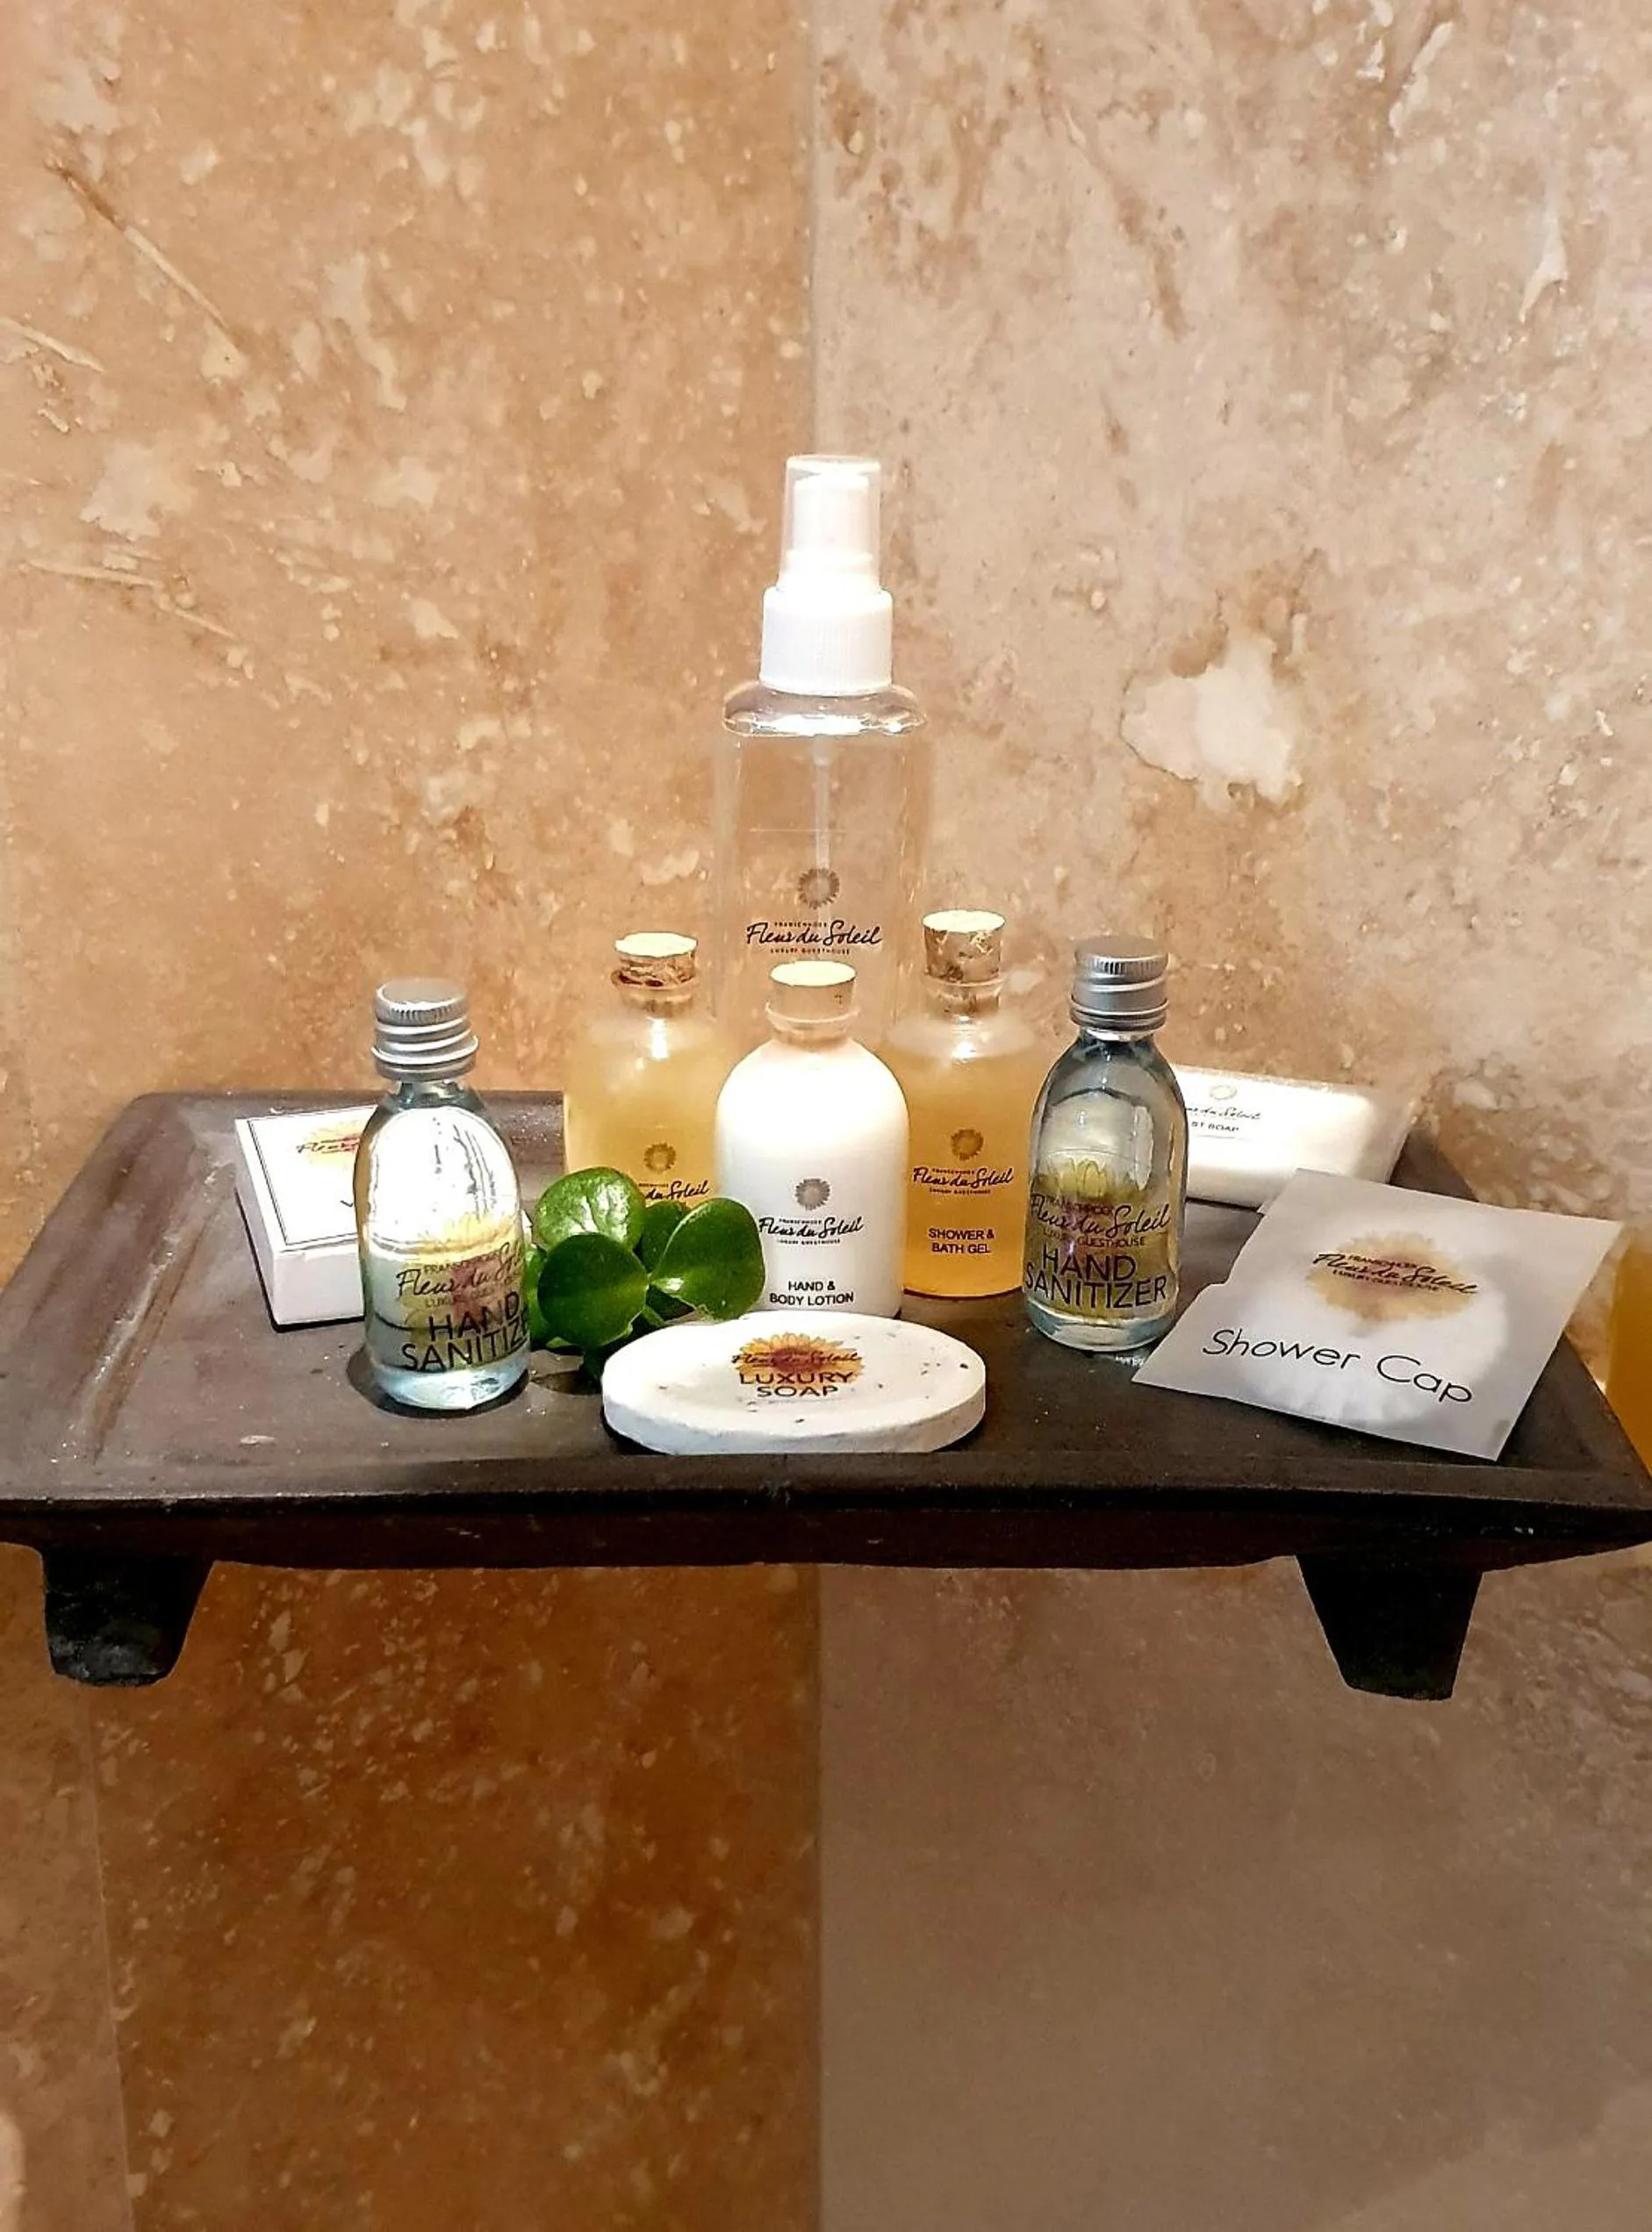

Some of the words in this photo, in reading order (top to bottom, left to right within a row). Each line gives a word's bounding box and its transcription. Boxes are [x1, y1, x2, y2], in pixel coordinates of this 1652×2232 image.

[746, 922, 795, 944] Fleur
[796, 927, 822, 944] du
[822, 920, 882, 946] Soleil
[913, 1166, 948, 1185] Fleur
[950, 1174, 971, 1187] du
[971, 1167, 1013, 1188] Soleil
[666, 1180, 709, 1201] Soleil
[1030, 1193, 1071, 1228] Fleur
[1073, 1215, 1104, 1234] du
[1105, 1203, 1172, 1238] Soleil
[758, 1216, 794, 1235] Fleur
[796, 1224, 818, 1238] du
[818, 1216, 865, 1238] Soleil
[928, 1228, 984, 1240] SHOWER
[986, 1229, 995, 1239] &
[931, 1242, 965, 1253] BATH
[967, 1244, 991, 1254] GEL
[1042, 1243, 1137, 1282] HAND
[396, 1267, 456, 1296] Fleur
[1024, 1261, 1167, 1309] SANITIZER
[1312, 1253, 1369, 1274] Fleur
[1371, 1266, 1399, 1279] du
[1403, 1266, 1479, 1295] Soleil
[787, 1281, 823, 1291] HAND
[827, 1281, 836, 1291] &
[769, 1292, 804, 1306] BODY
[808, 1291, 854, 1306] LOTION
[428, 1290, 521, 1342] HAND
[1203, 1328, 1361, 1369] Shower
[1376, 1354, 1473, 1403] Cap
[738, 1372, 854, 1385] LUXURY
[757, 1385, 839, 1397] SOAP
